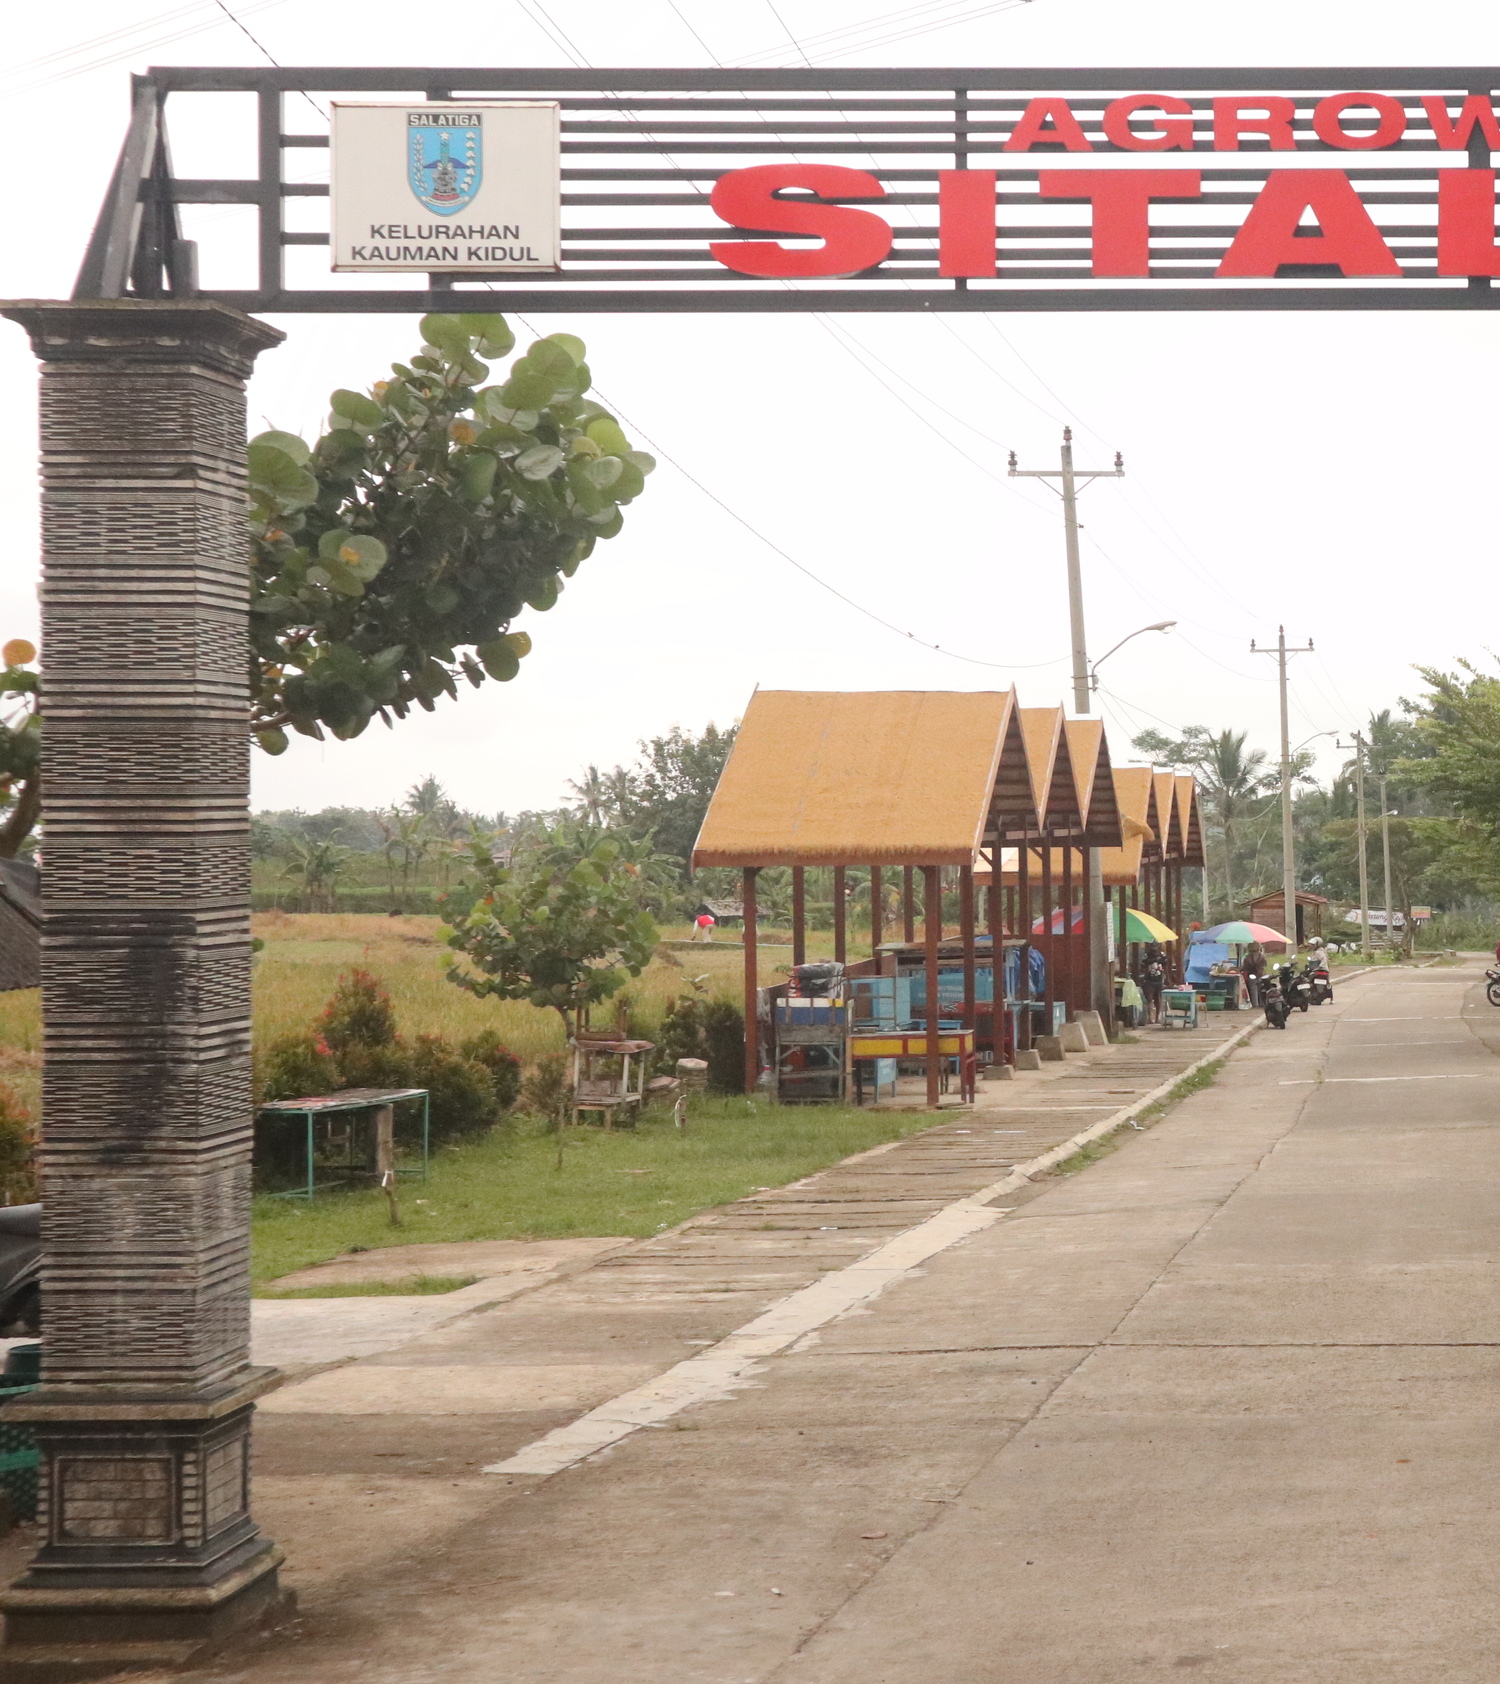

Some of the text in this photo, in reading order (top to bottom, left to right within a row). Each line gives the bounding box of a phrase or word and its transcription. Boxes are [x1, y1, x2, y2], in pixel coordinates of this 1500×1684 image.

[409, 114, 480, 126] SALATIGA
[370, 224, 520, 240] KELURAHAN
[351, 246, 540, 262] KAUMAN KIDUL
